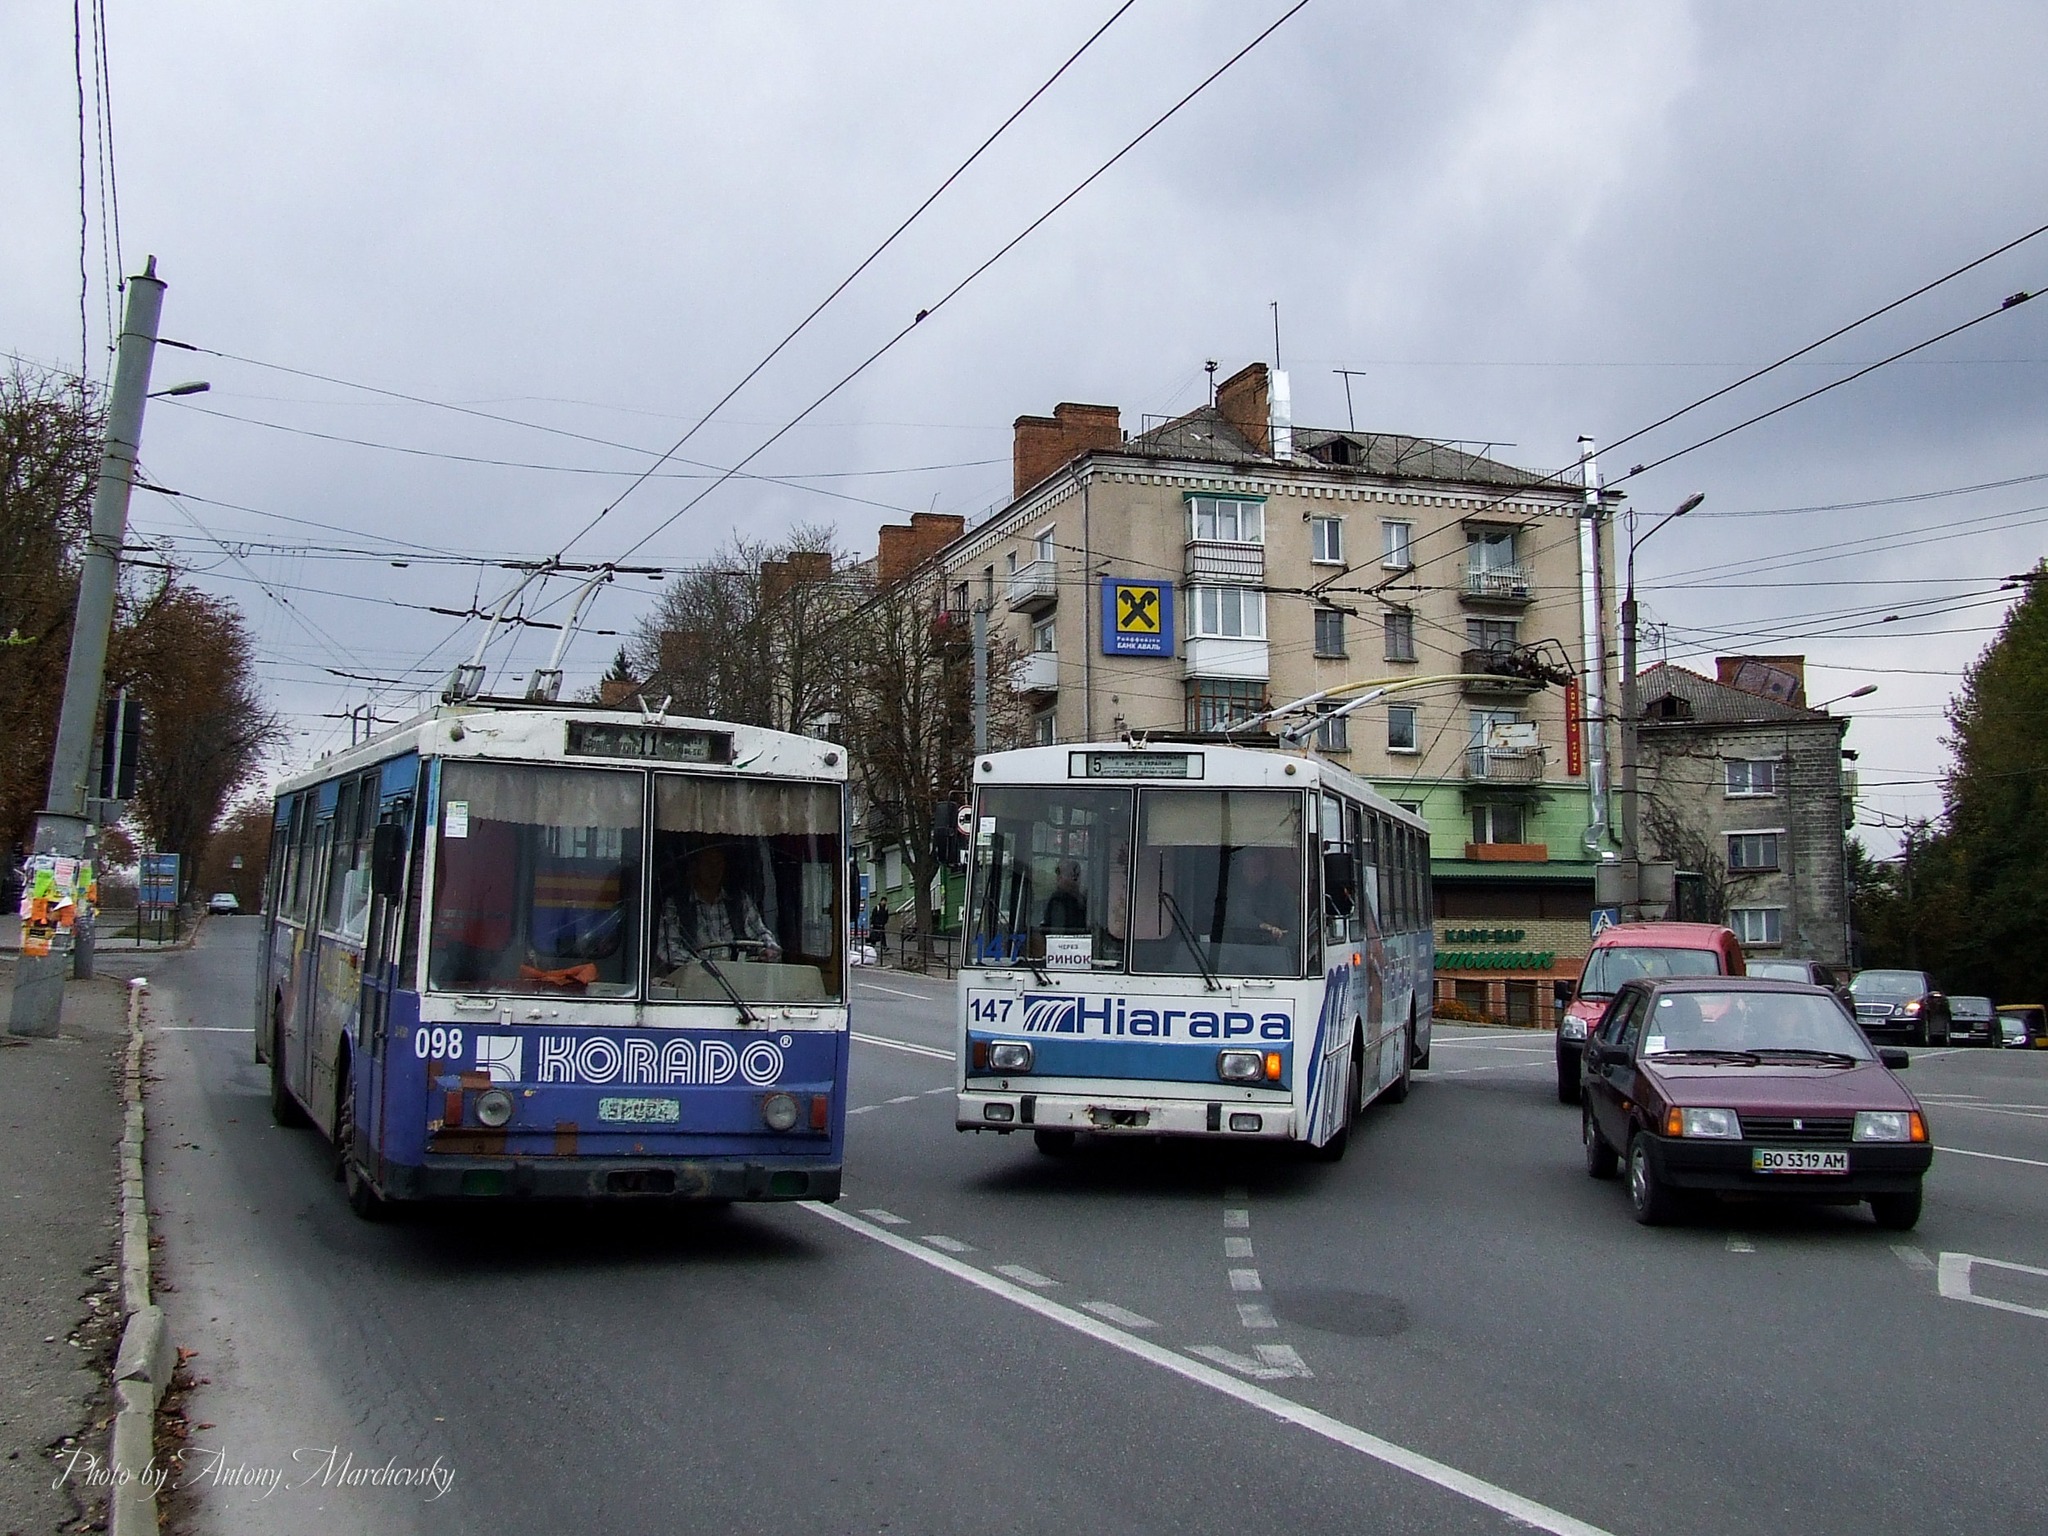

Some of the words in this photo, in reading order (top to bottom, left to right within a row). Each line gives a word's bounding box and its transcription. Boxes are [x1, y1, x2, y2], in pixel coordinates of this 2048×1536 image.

[1137, 643, 1161, 651] АВАЛЬ
[639, 732, 658, 756] 11
[1093, 757, 1102, 773] 5
[971, 933, 1027, 962] 147
[1047, 954, 1092, 965] РИНОК
[970, 998, 1014, 1023] 147
[1076, 997, 1292, 1040] Ніагара
[415, 1027, 463, 1059] 098
[1787, 1153, 1820, 1168] 5319
